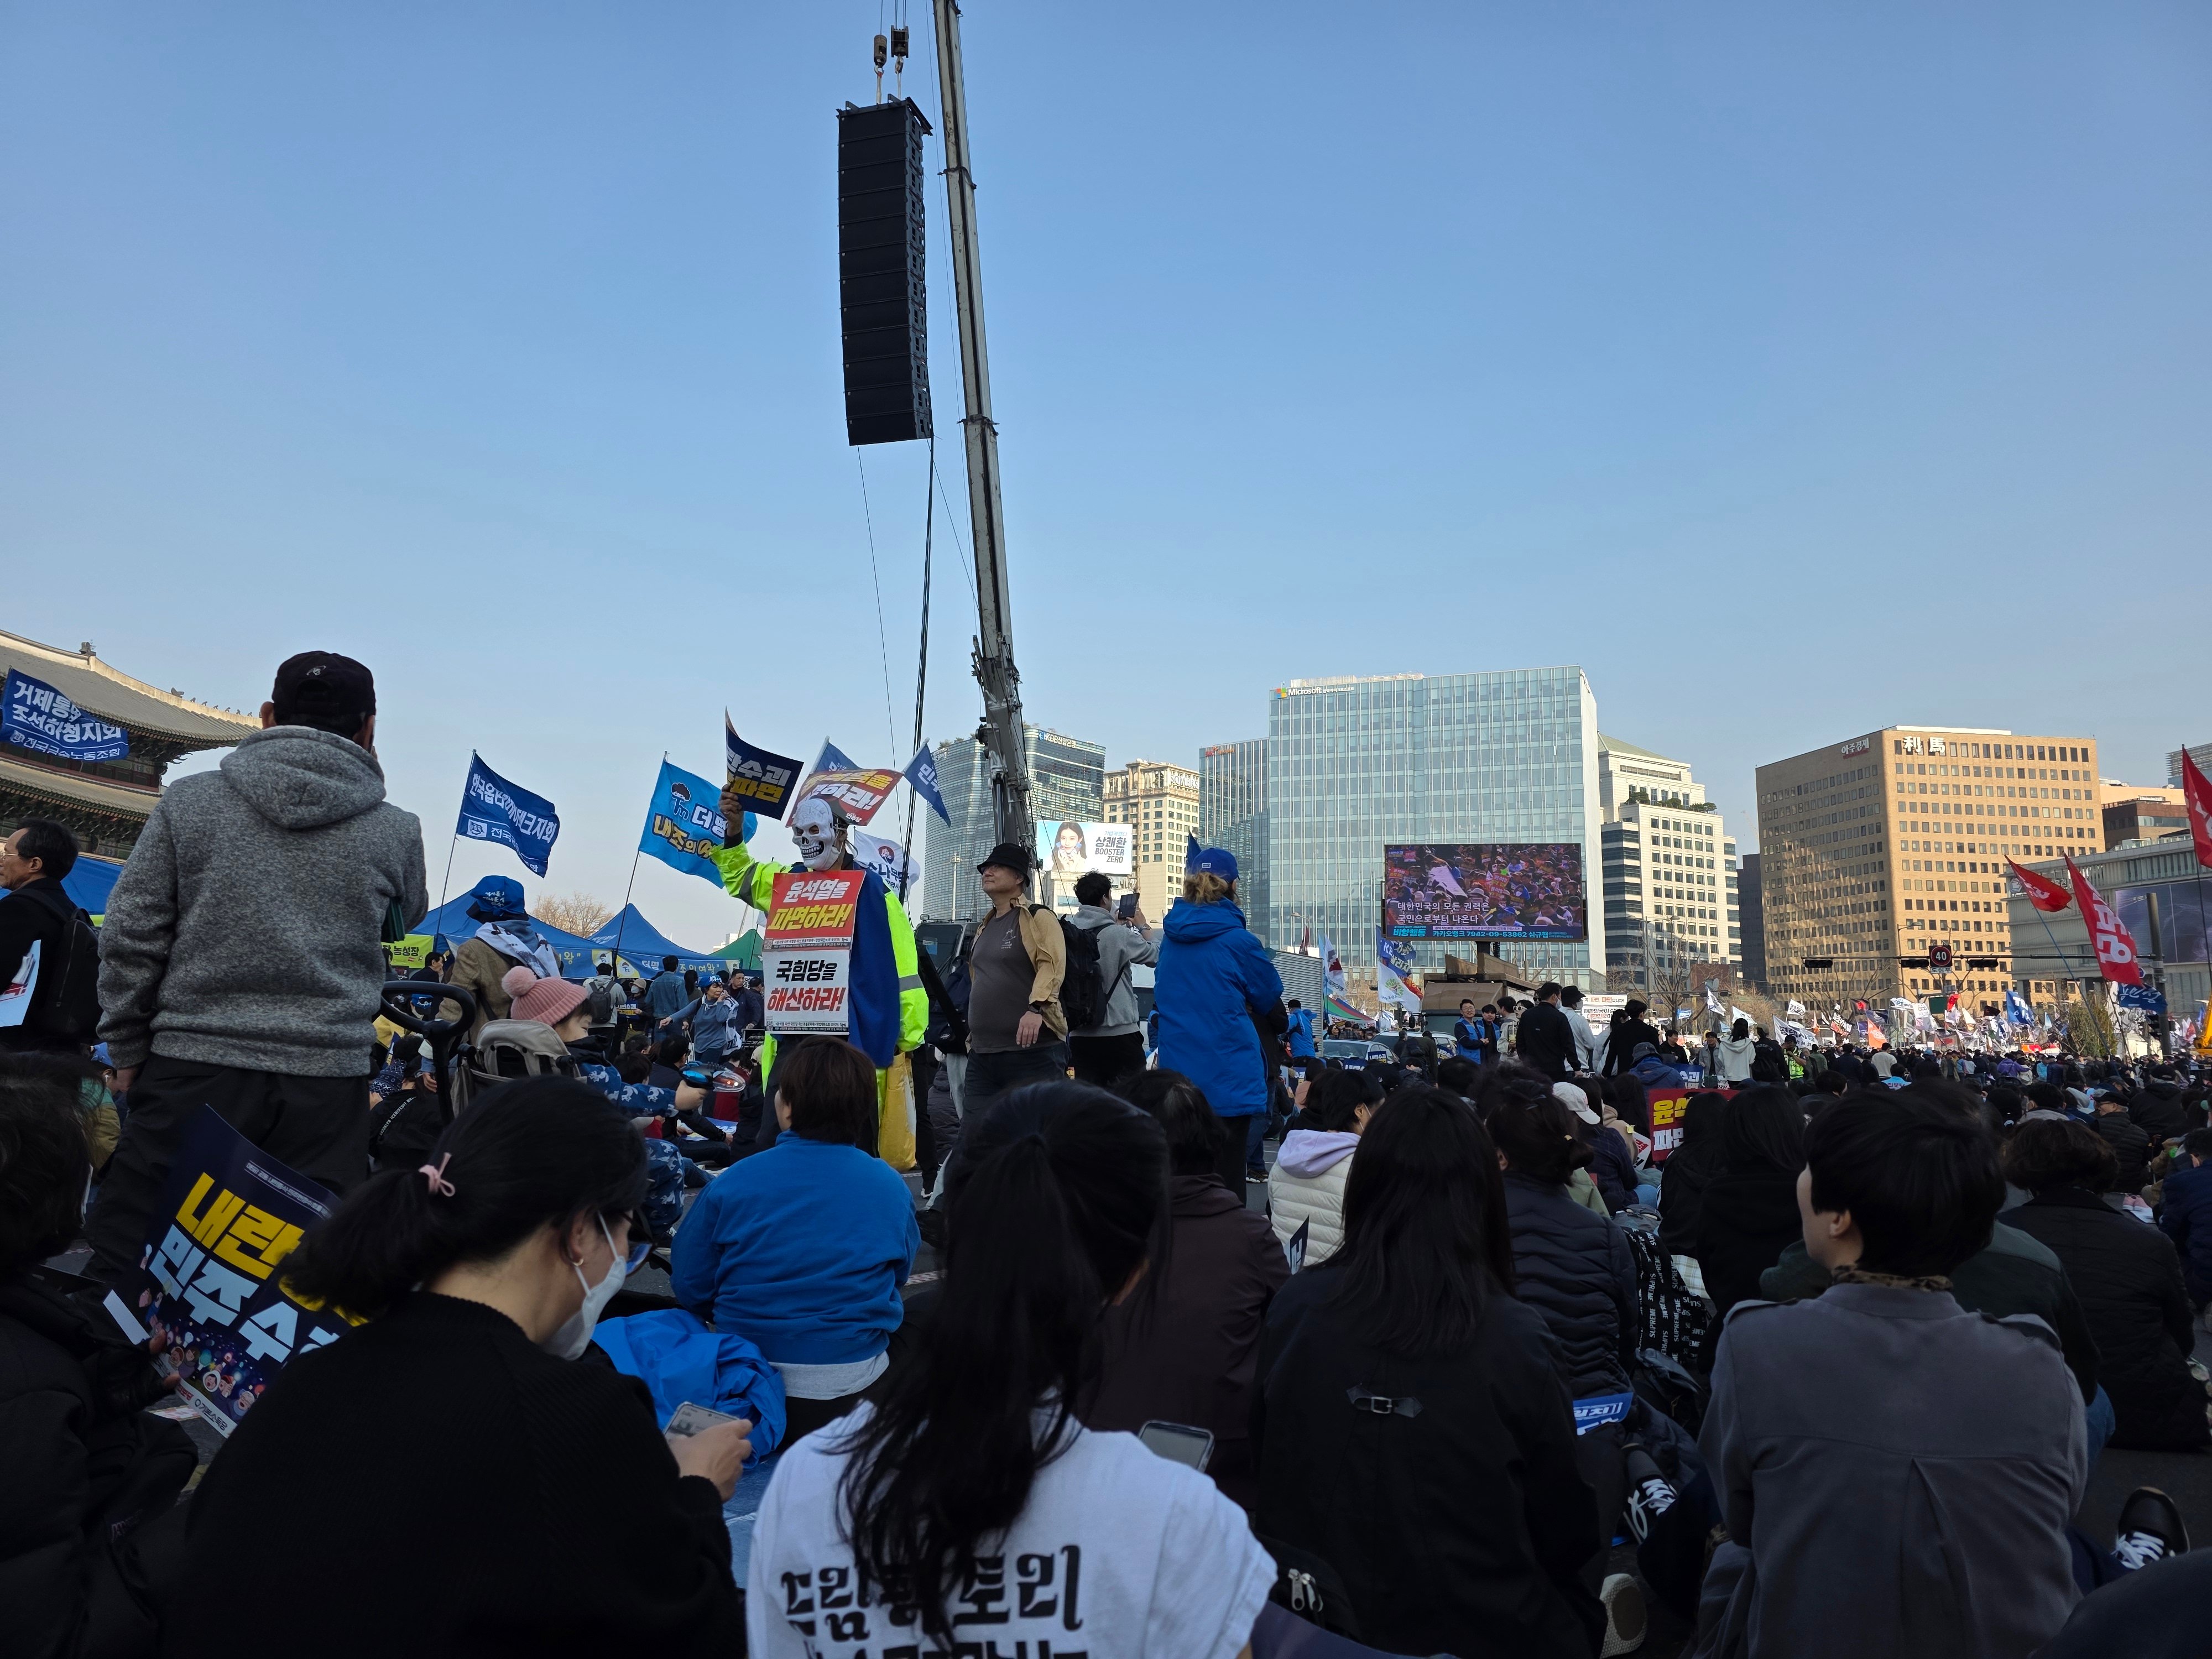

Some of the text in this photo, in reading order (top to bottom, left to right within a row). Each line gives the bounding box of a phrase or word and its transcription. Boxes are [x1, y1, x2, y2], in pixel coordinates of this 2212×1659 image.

[1288, 687, 1322, 696] Microsoft
[13, 704, 121, 743] 조선하청지회
[1841, 738, 1869, 755] 아주경제
[1903, 736, 1945, 753] 利馬
[1095, 837, 1126, 848] 상쾌환
[783, 879, 851, 902] 윤석열을
[1398, 902, 1490, 911] 대한민국의 모든 권력은
[767, 904, 854, 930] 파면하라!
[1398, 915, 1479, 924] 국민으로부터 나온다
[394, 946, 419, 956] 농성장
[1936, 952, 1947, 961] 40
[776, 960, 837, 982] 국힘당을
[767, 988, 846, 1011] 해산하라!
[1648, 1273, 1656, 1302] SUPREME
